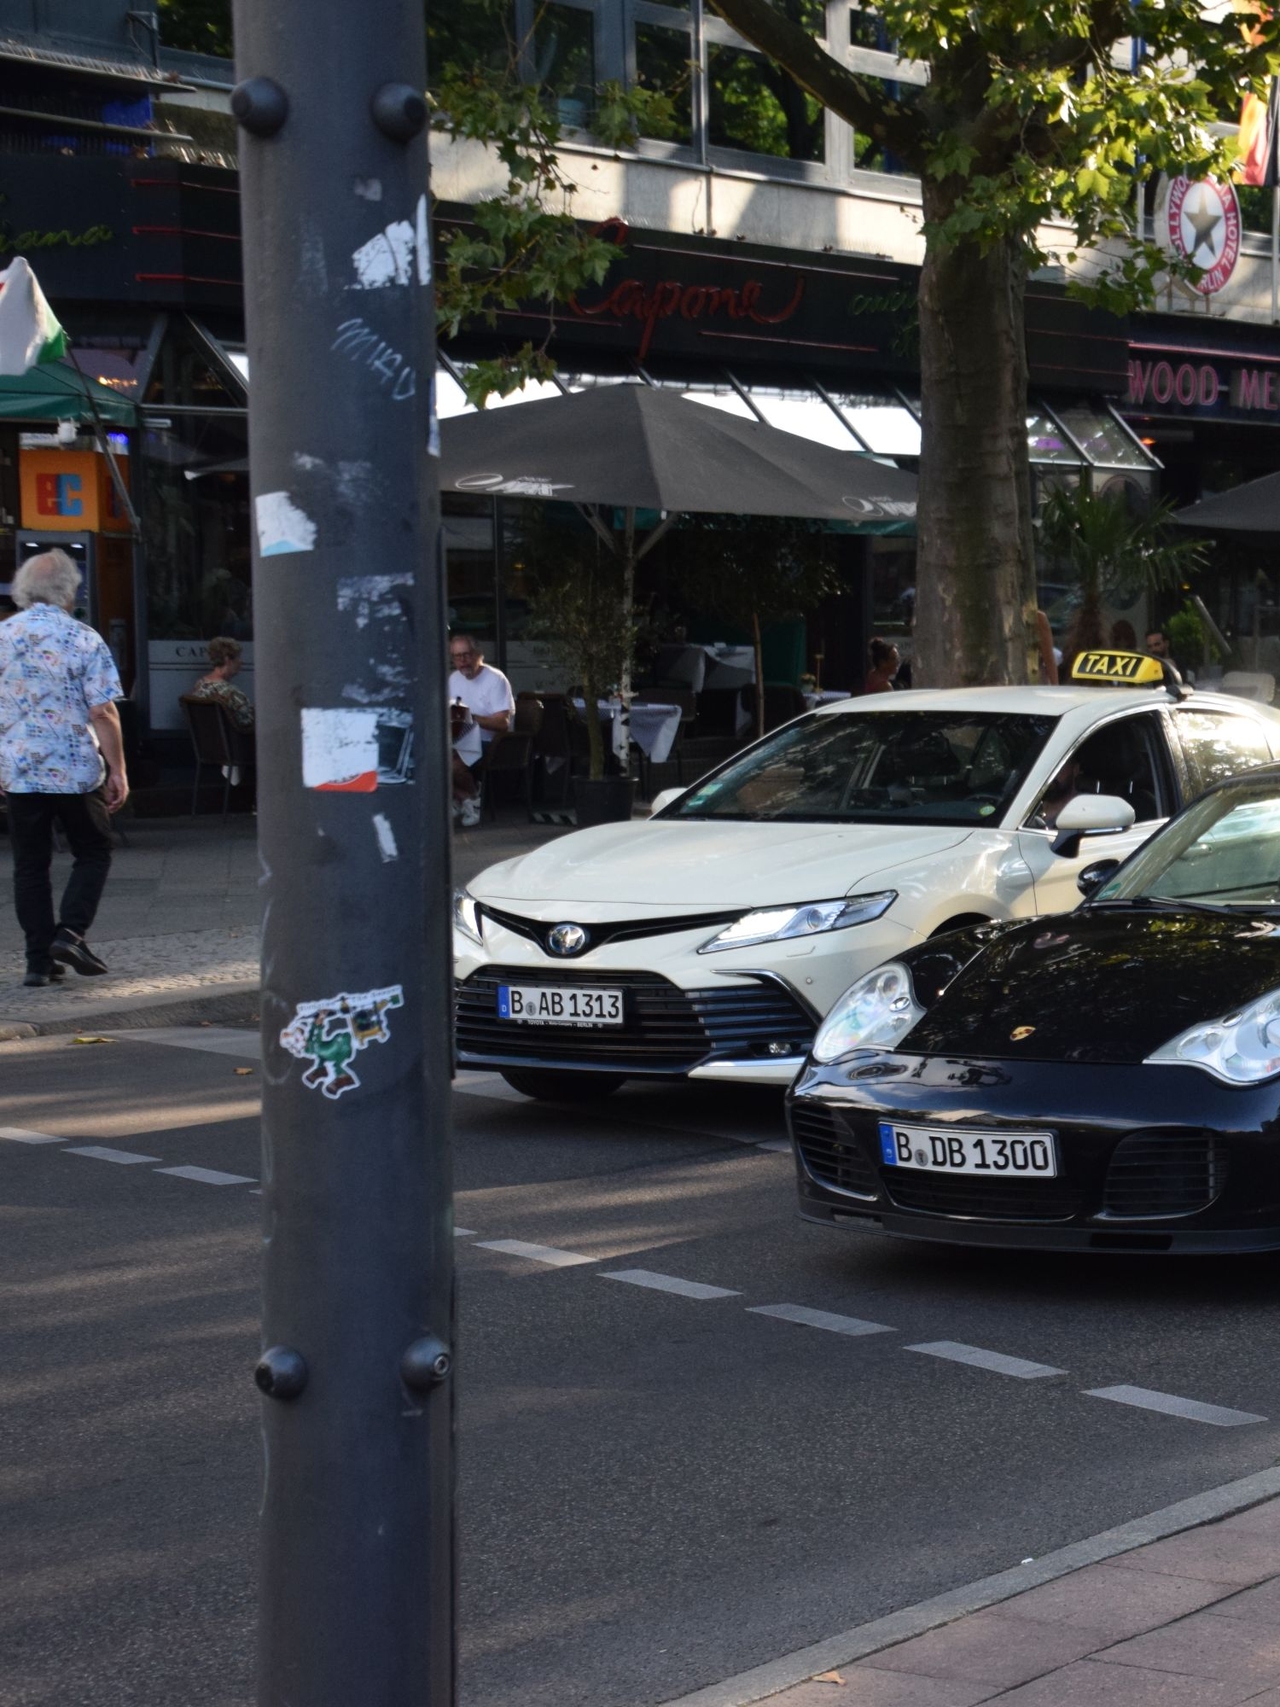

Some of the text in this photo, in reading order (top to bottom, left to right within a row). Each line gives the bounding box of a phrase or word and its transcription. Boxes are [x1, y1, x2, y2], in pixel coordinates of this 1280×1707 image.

[1221, 211, 1238, 270] HOTEL
[175, 646, 208, 658] CAP
[1085, 655, 1137, 676] TAXI
[511, 990, 620, 1019] B AB 1313
[896, 1131, 1050, 1171] B DB 1300
